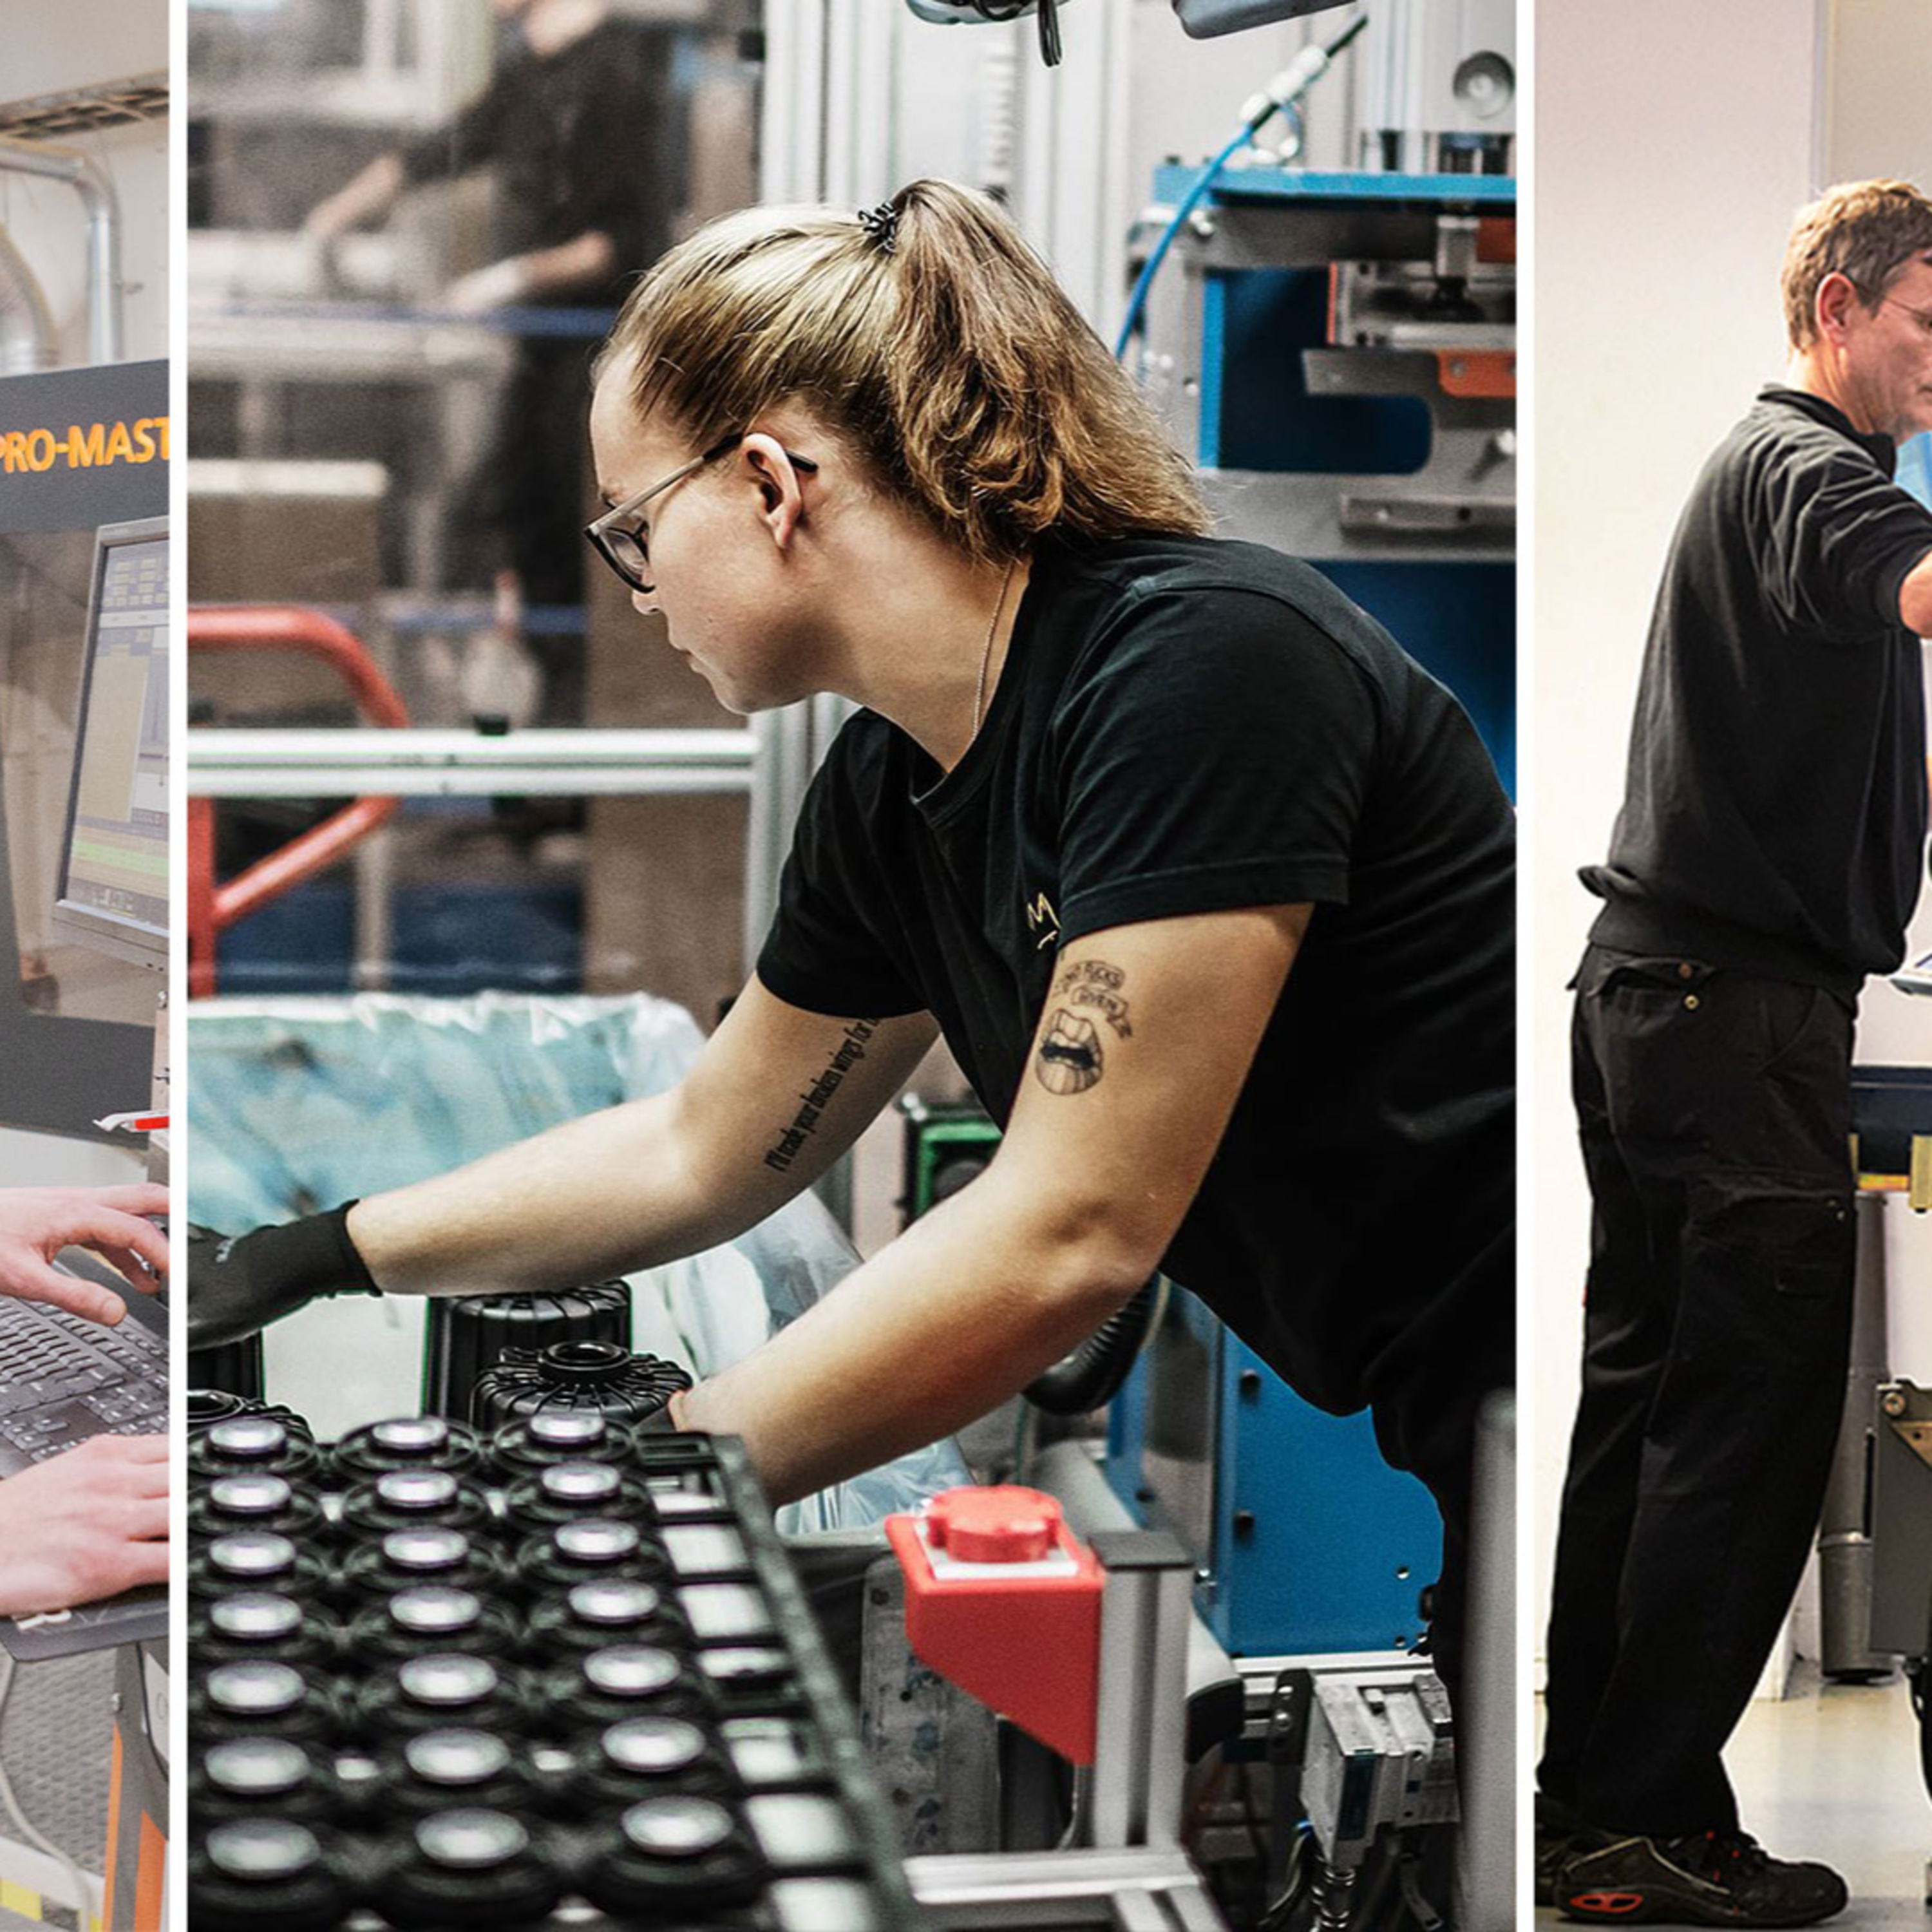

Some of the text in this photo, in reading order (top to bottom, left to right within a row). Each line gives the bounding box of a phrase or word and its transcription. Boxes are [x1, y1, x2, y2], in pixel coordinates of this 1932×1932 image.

[844, 1022, 873, 1043] for
[828, 1038, 866, 1072] wings
[800, 1069, 844, 1108] broken
